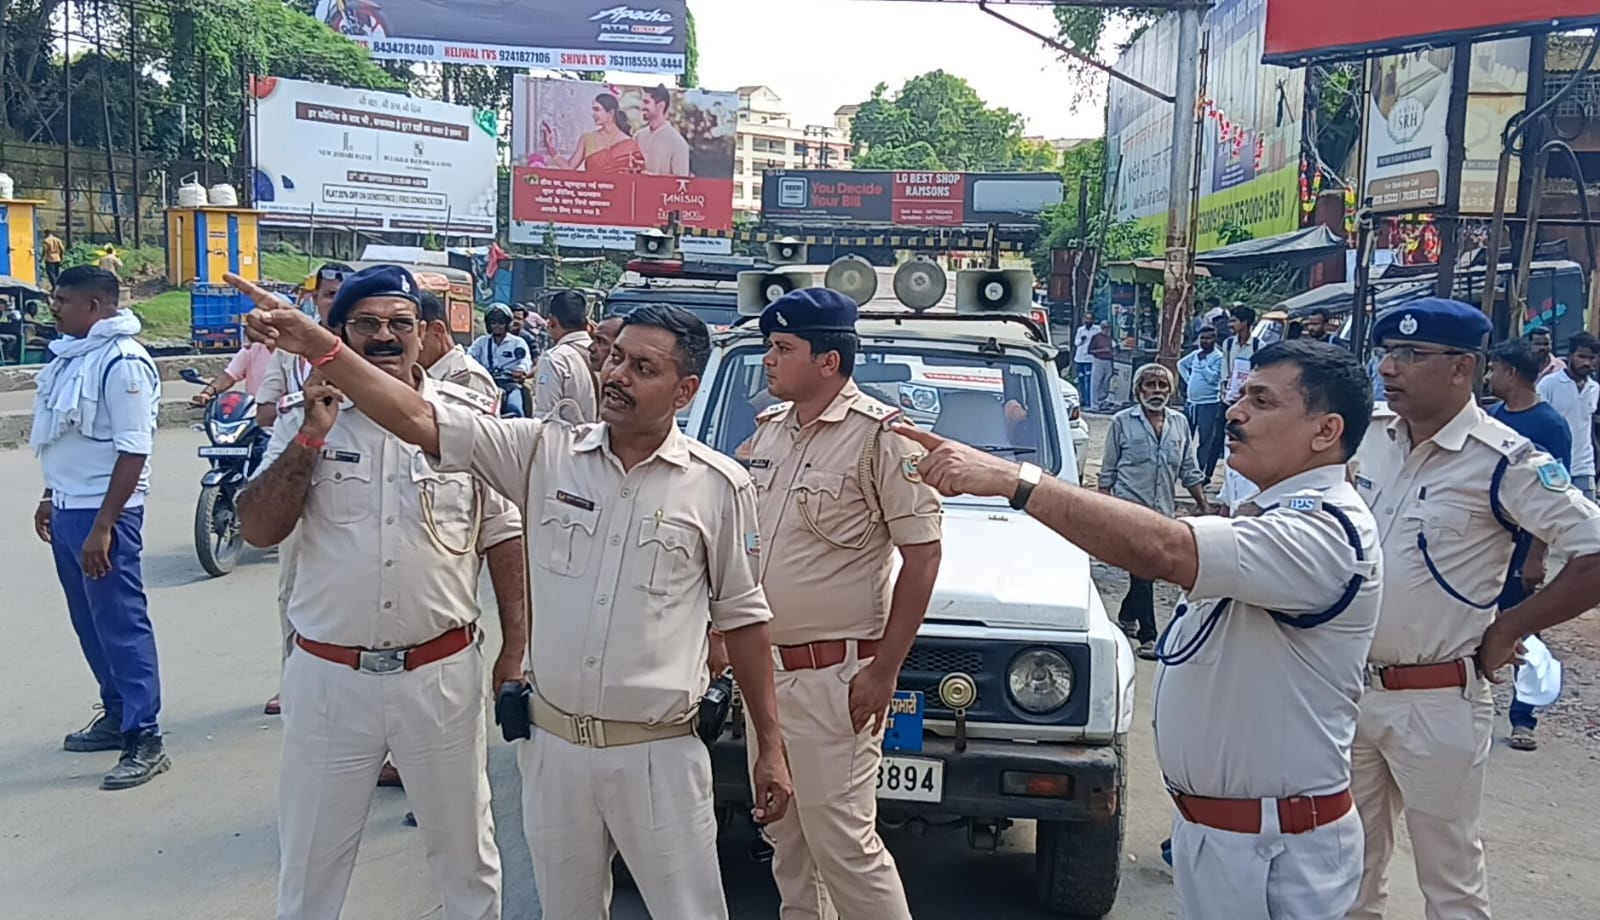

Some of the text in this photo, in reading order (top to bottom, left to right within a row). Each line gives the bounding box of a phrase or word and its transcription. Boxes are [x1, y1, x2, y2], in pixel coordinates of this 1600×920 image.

[589, 6, 672, 23] Apache
[373, 41, 434, 56] 8434282400
[481, 49, 497, 60] TVS
[499, 50, 550, 64] 9241827106
[560, 53, 587, 65] SHIVA
[590, 54, 606, 66] TVS
[1398, 112, 1418, 130] SRH
[896, 173, 960, 184] LG BEST SHOP
[812, 182, 882, 194] You Decide
[905, 185, 950, 197] RAMSONS
[661, 192, 705, 208] TANISHQ
[812, 195, 861, 207] Your Bill
